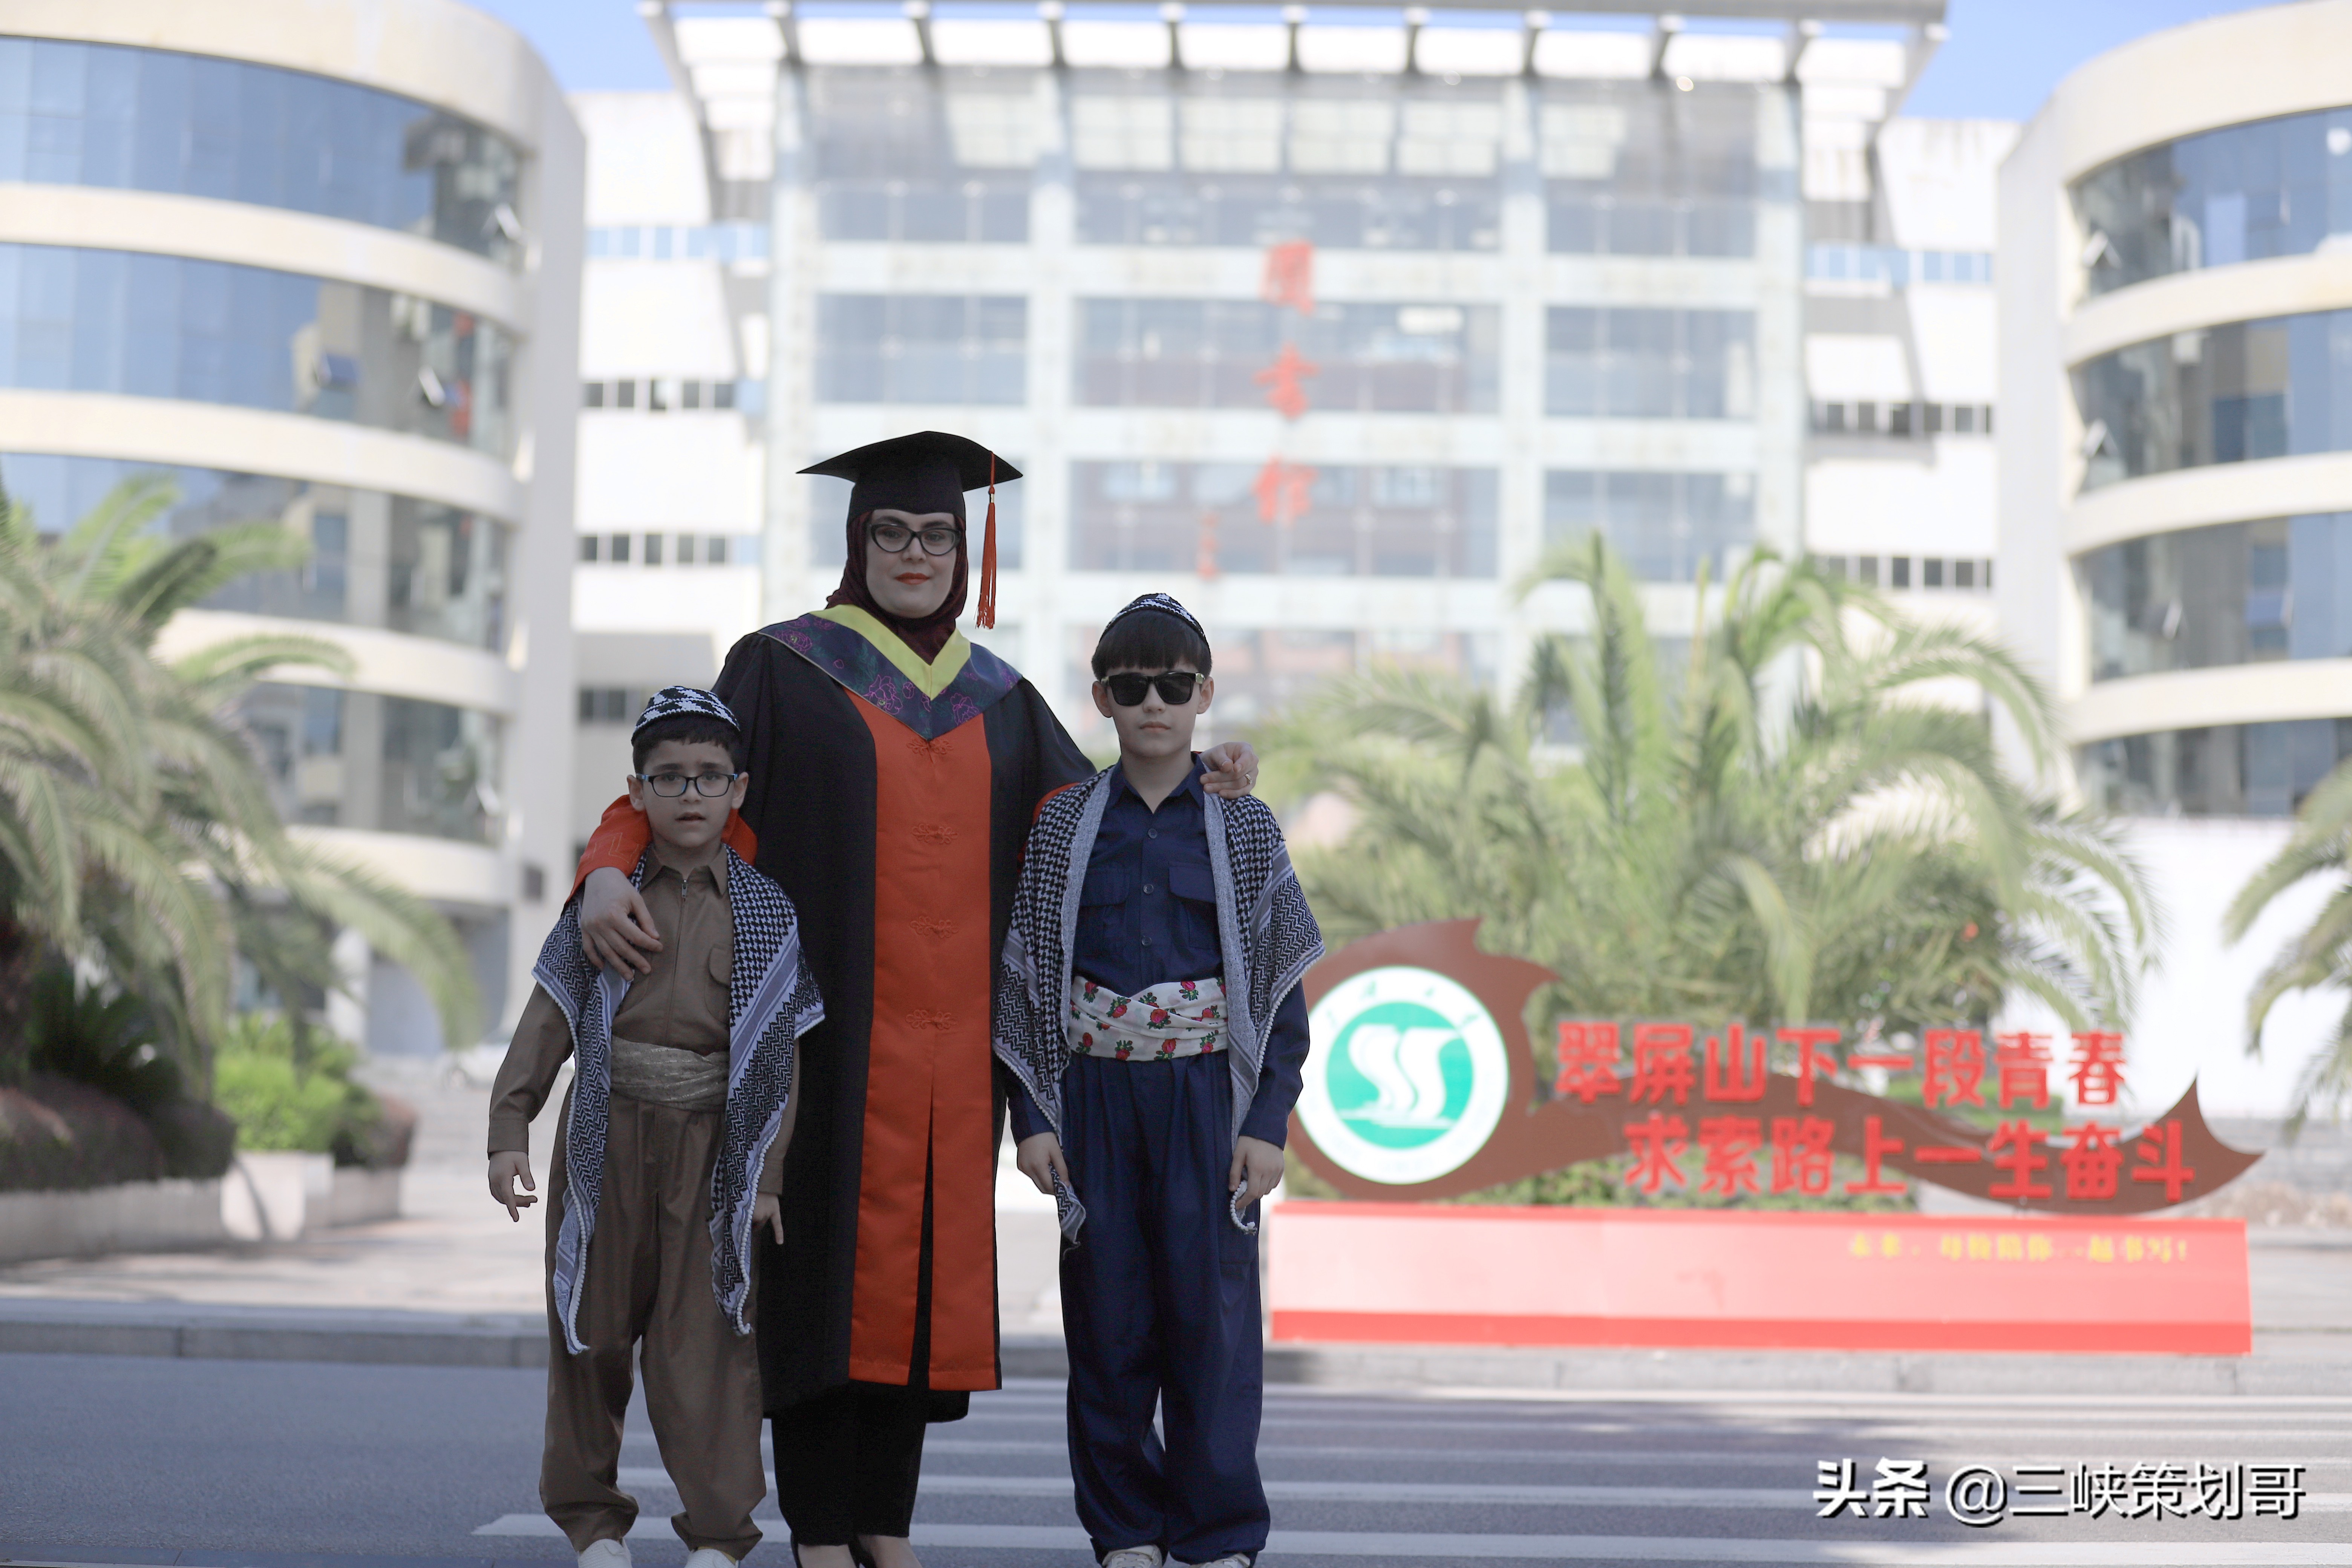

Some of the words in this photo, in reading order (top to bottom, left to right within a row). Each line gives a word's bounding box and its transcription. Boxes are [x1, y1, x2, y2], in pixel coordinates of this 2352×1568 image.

[1555, 1021, 2127, 1109] 翠屏山下一段青春
[1623, 1112, 2195, 1203] 求索路上一生奋斗
